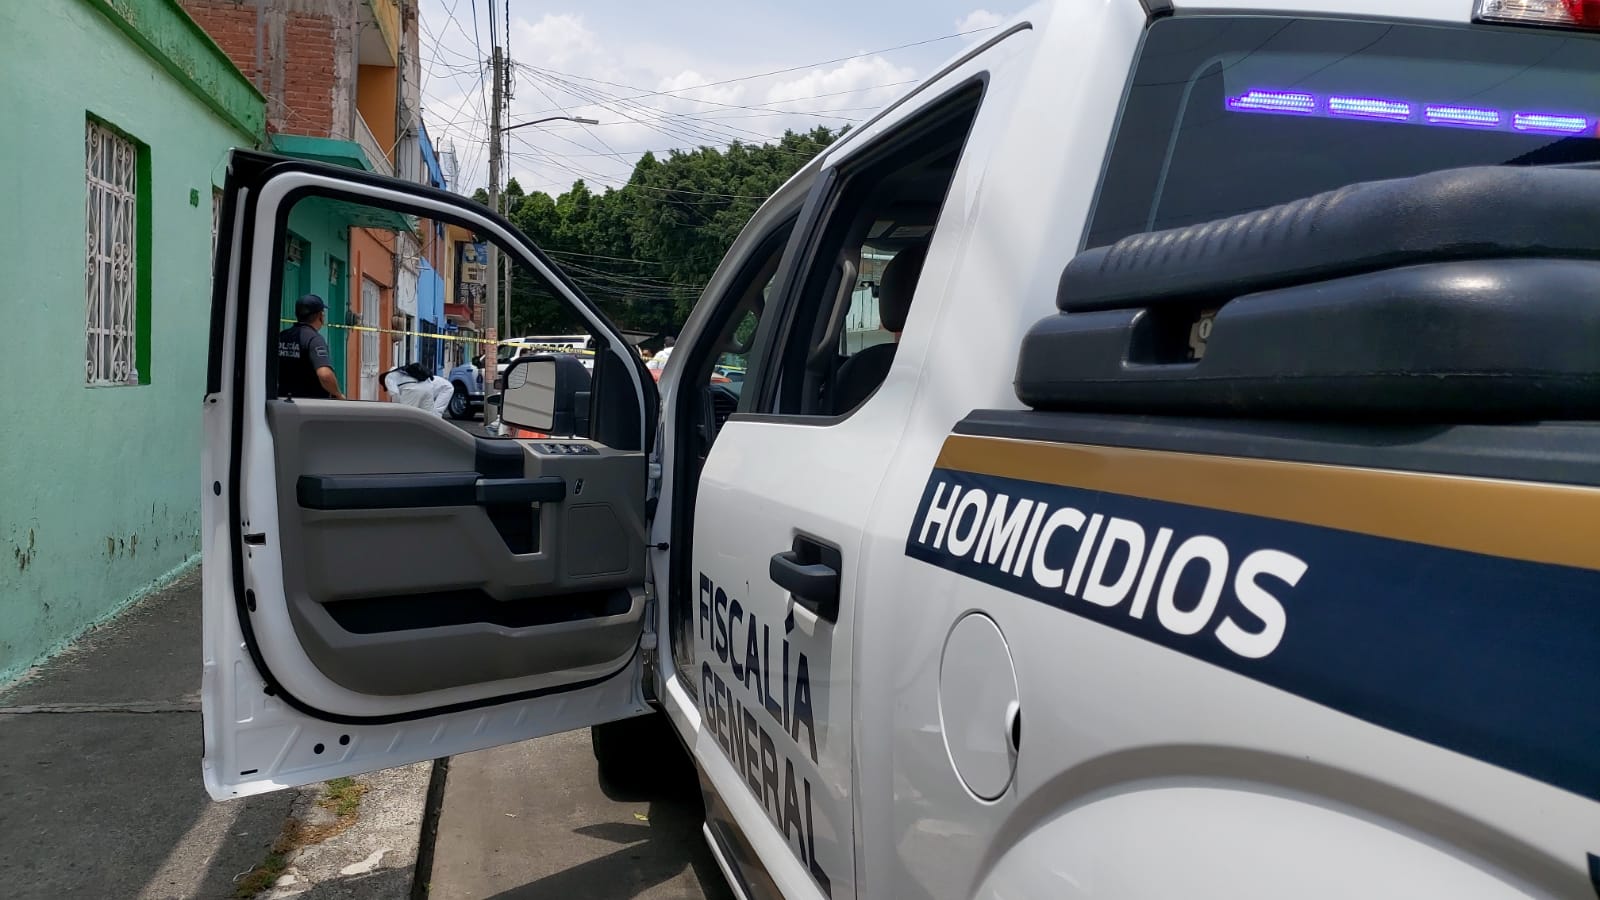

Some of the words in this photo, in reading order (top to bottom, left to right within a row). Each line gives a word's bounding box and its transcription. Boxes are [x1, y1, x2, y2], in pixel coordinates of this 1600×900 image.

[918, 481, 1308, 659] HOMICIDIOS
[699, 571, 818, 764] FISCALÍA
[701, 660, 832, 899] GENERAL
